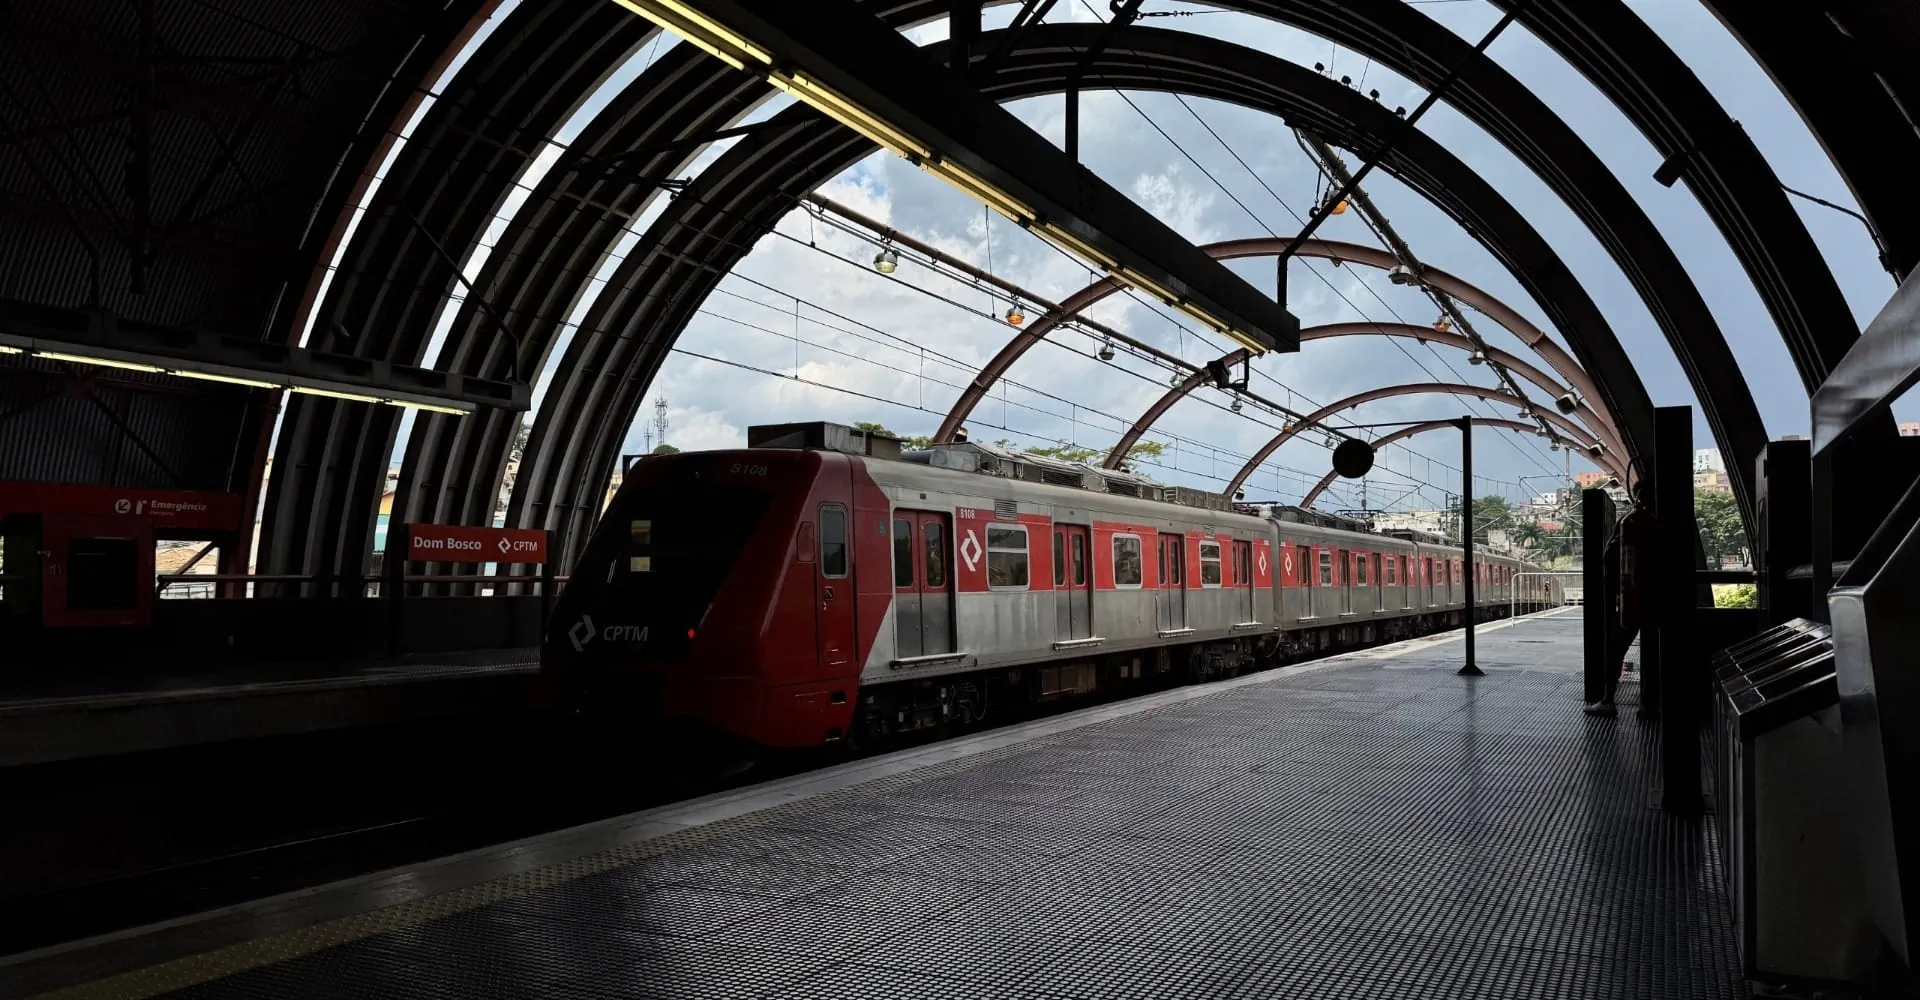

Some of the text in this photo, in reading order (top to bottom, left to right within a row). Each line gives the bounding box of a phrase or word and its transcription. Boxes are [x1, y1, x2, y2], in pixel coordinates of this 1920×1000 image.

[151, 500, 207, 512] Emergência
[413, 536, 482, 551] Dom Bosco
[513, 540, 538, 552] CPTM
[604, 625, 649, 642] CPTM
